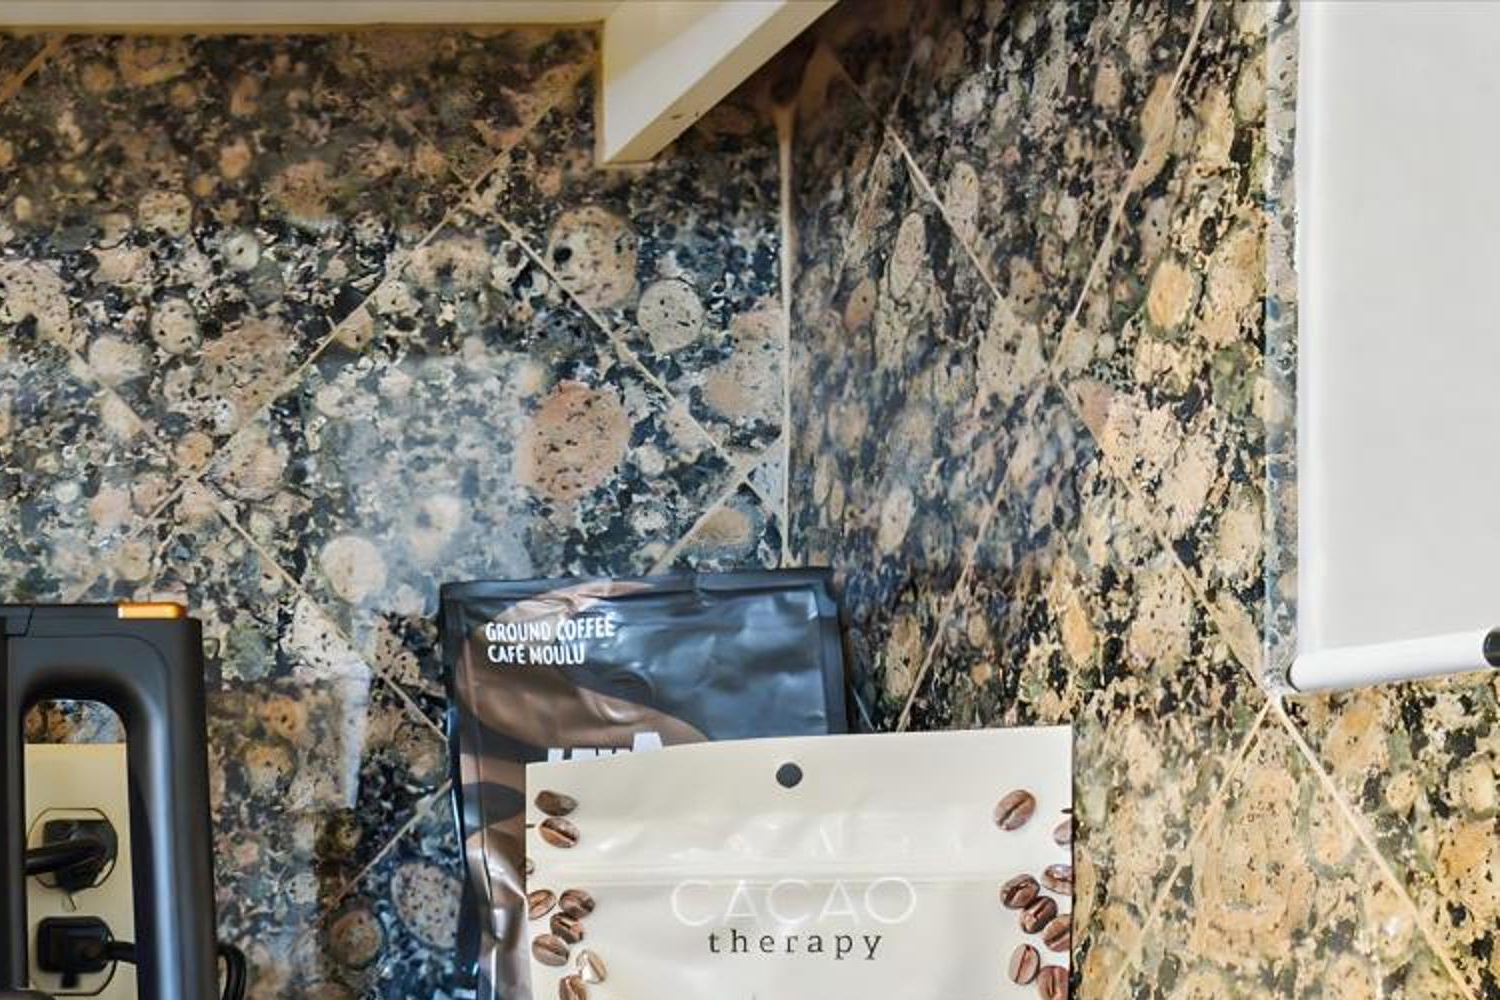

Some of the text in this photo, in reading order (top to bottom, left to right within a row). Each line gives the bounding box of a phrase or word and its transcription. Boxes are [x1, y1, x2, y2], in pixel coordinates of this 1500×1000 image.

[485, 616, 616, 642] GROUND COFFEE
[529, 641, 585, 665] MOULU
[671, 877, 917, 926] CACAO
[707, 928, 882, 960] therapy
